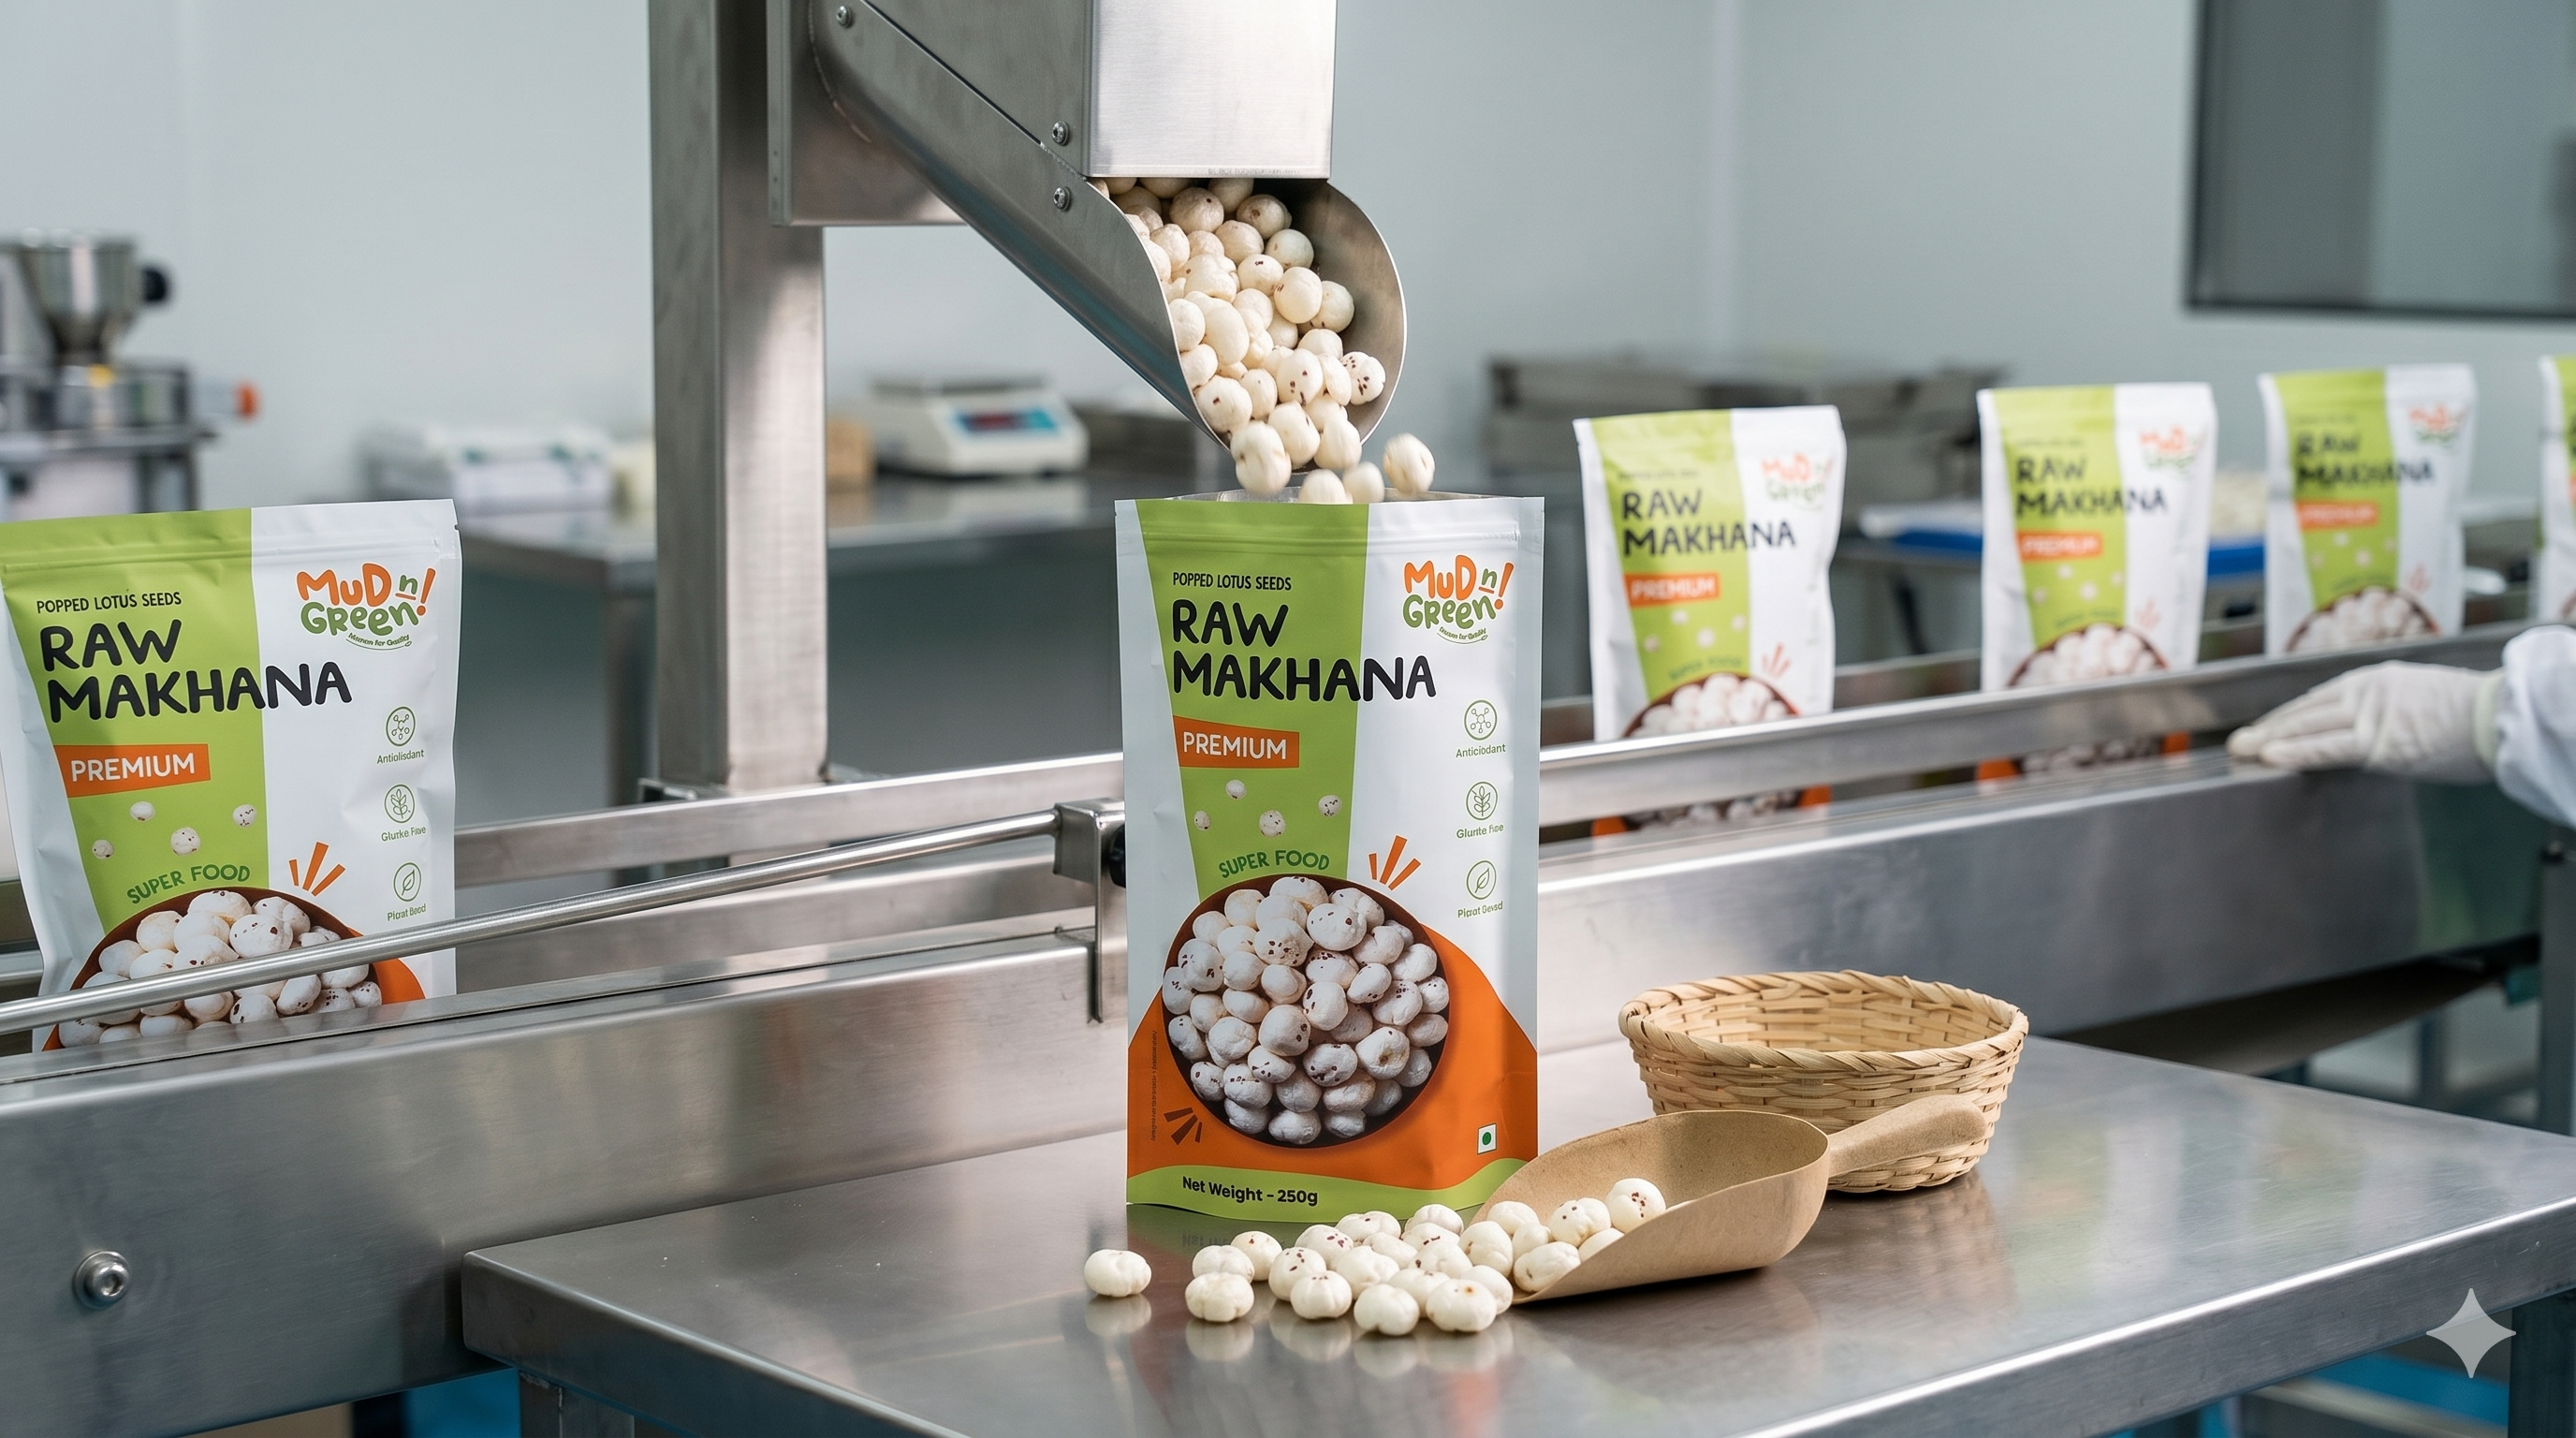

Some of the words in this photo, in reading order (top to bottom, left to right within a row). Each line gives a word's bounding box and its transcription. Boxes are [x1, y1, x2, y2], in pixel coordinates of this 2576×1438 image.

[2017, 455, 2086, 483] RAW
[1621, 489, 1702, 521] RAW
[2016, 487, 2168, 520] MAKHANA
[1623, 521, 1796, 556] MAKHANA
[1173, 572, 1214, 587] POPPED
[1217, 575, 1252, 589] LOTUS
[1255, 576, 1292, 591] SEEDS
[1630, 577, 1717, 602] PREMIUM
[37, 597, 90, 614] POPPED
[95, 594, 138, 610] LOTUS
[142, 591, 183, 608] SEEDS
[1172, 599, 1289, 648] RAW
[39, 619, 182, 672] RAW
[1173, 650, 1437, 702] MAKHANA
[47, 661, 353, 724] MAKHANA
[1182, 731, 1287, 760] PREMIUM
[70, 752, 196, 782] PREMIUM
[1218, 851, 1270, 879] SUPER
[1275, 849, 1330, 871] FOOD
[126, 871, 184, 904] SUPER
[191, 863, 251, 882] FOOD
[1182, 1176, 1206, 1193] Net
[1208, 1181, 1263, 1203] Weight
[1277, 1189, 1318, 1207] 250g
